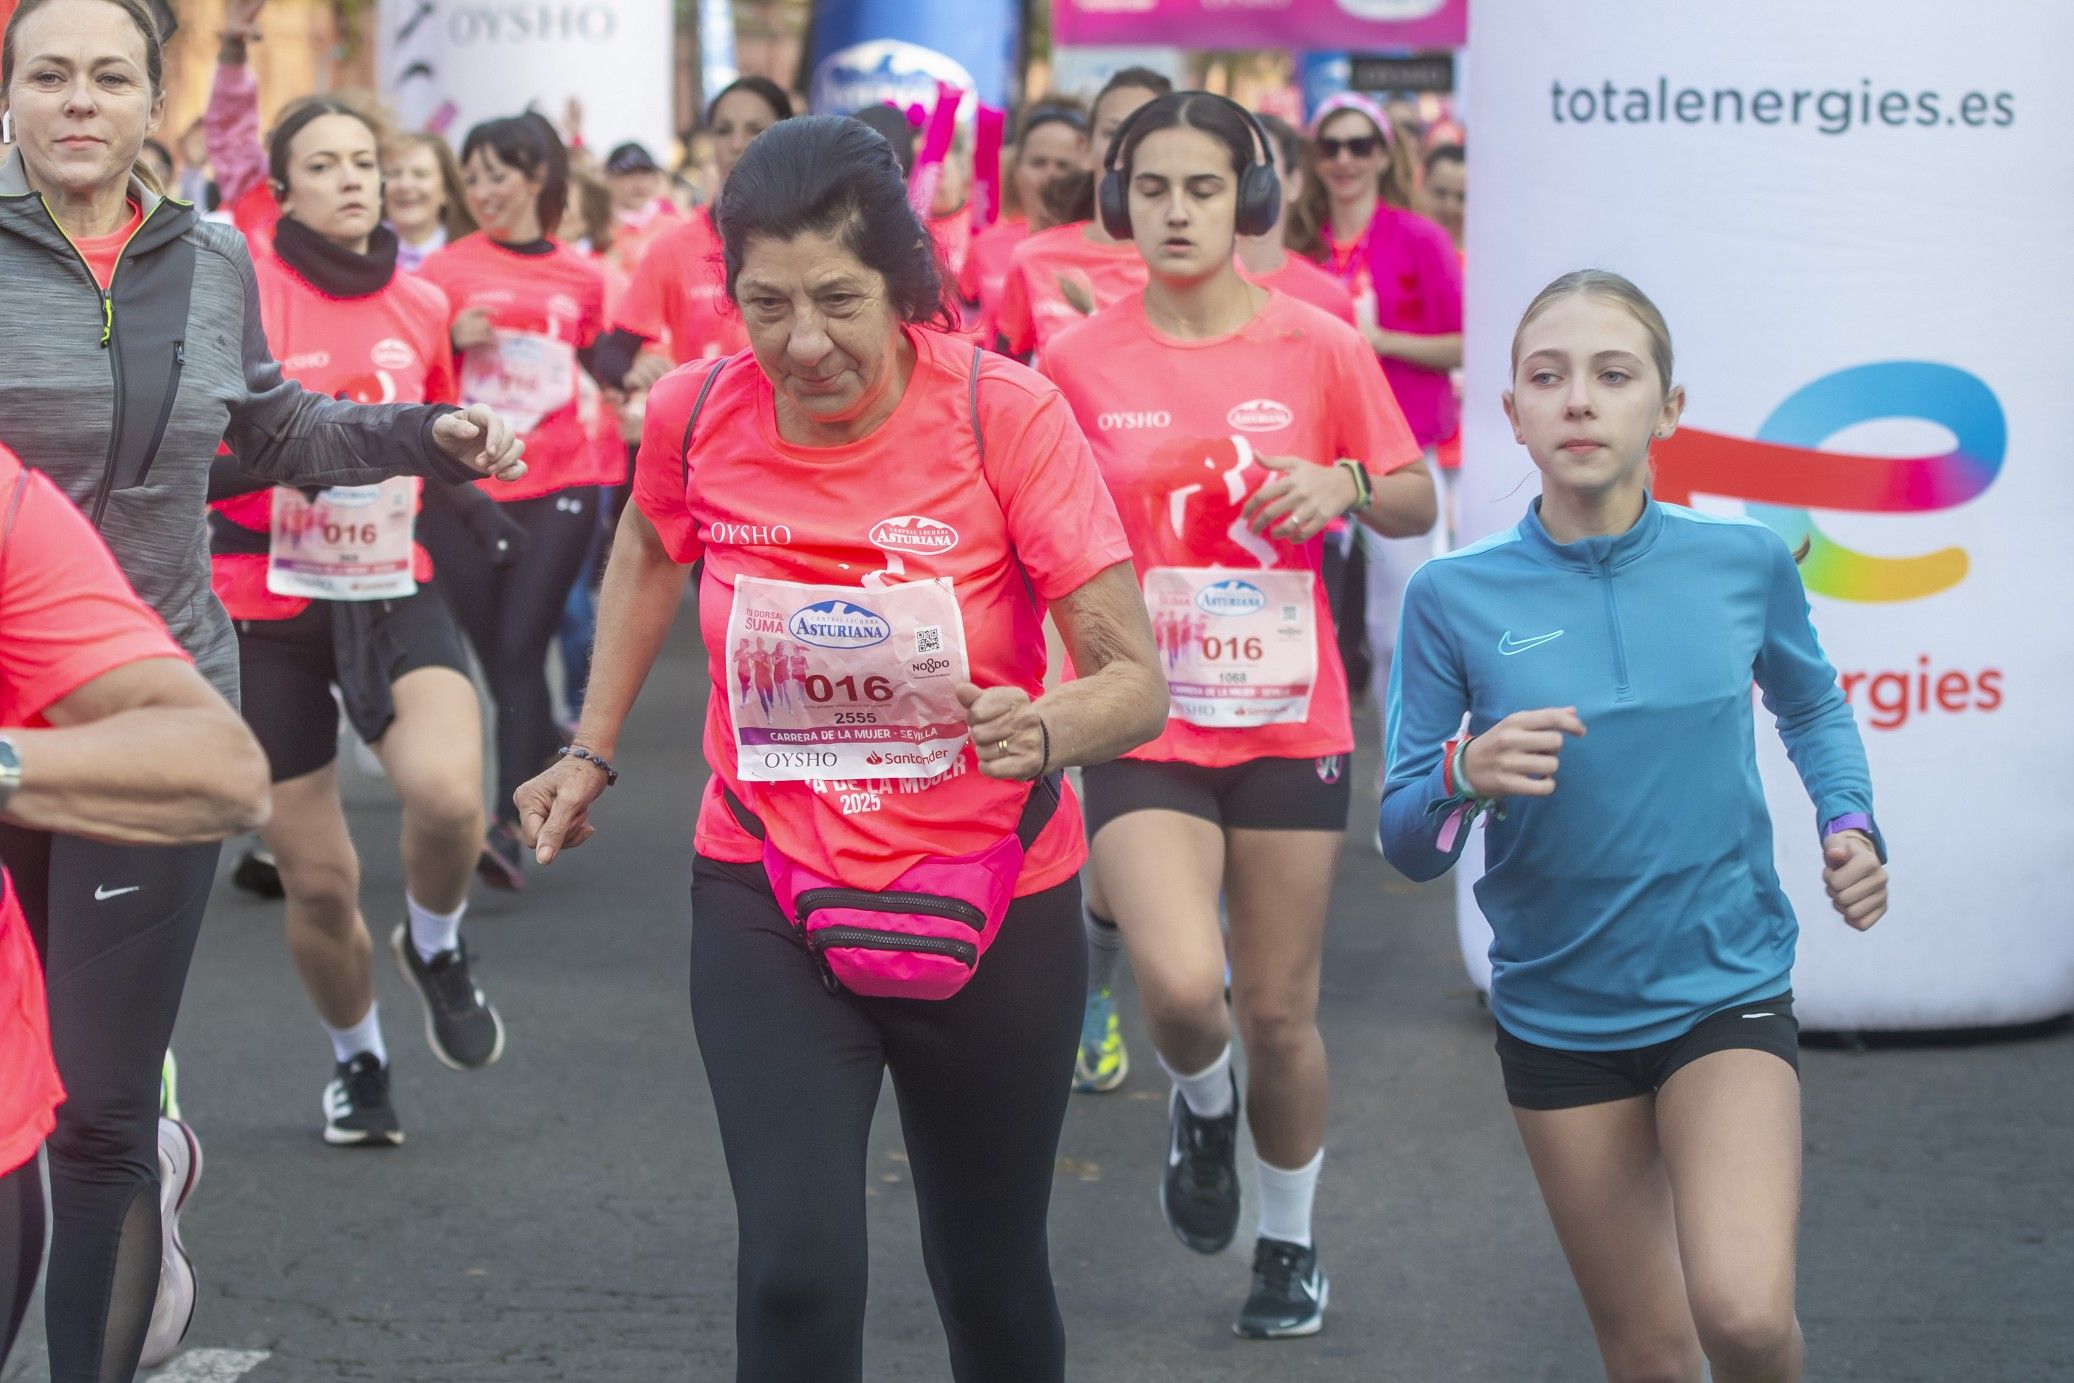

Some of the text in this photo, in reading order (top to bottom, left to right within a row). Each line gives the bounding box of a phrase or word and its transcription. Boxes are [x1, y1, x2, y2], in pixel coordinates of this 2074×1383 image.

[450, 2, 618, 47] OYSHO
[1550, 76, 2016, 135] totalenergies.es
[1097, 411, 1171, 431] OYSHO
[323, 522, 377, 545] 016
[710, 521, 791, 545] OYSHO
[876, 530, 952, 547] ASTURIANA
[754, 609, 784, 621] DORSAL
[745, 617, 784, 635] SUMA
[796, 617, 883, 638] ASTURIANA
[1202, 636, 1264, 661] 016
[1218, 672, 1248, 683] 1068
[805, 674, 894, 702] 016
[834, 711, 877, 725] 2555
[770, 727, 938, 743] CARRERA DE LA MUJER SEVILLA
[764, 751, 838, 769] OYSHO
[884, 748, 949, 766] Santander
[866, 777, 894, 795] LA
[839, 792, 881, 816] 2025
